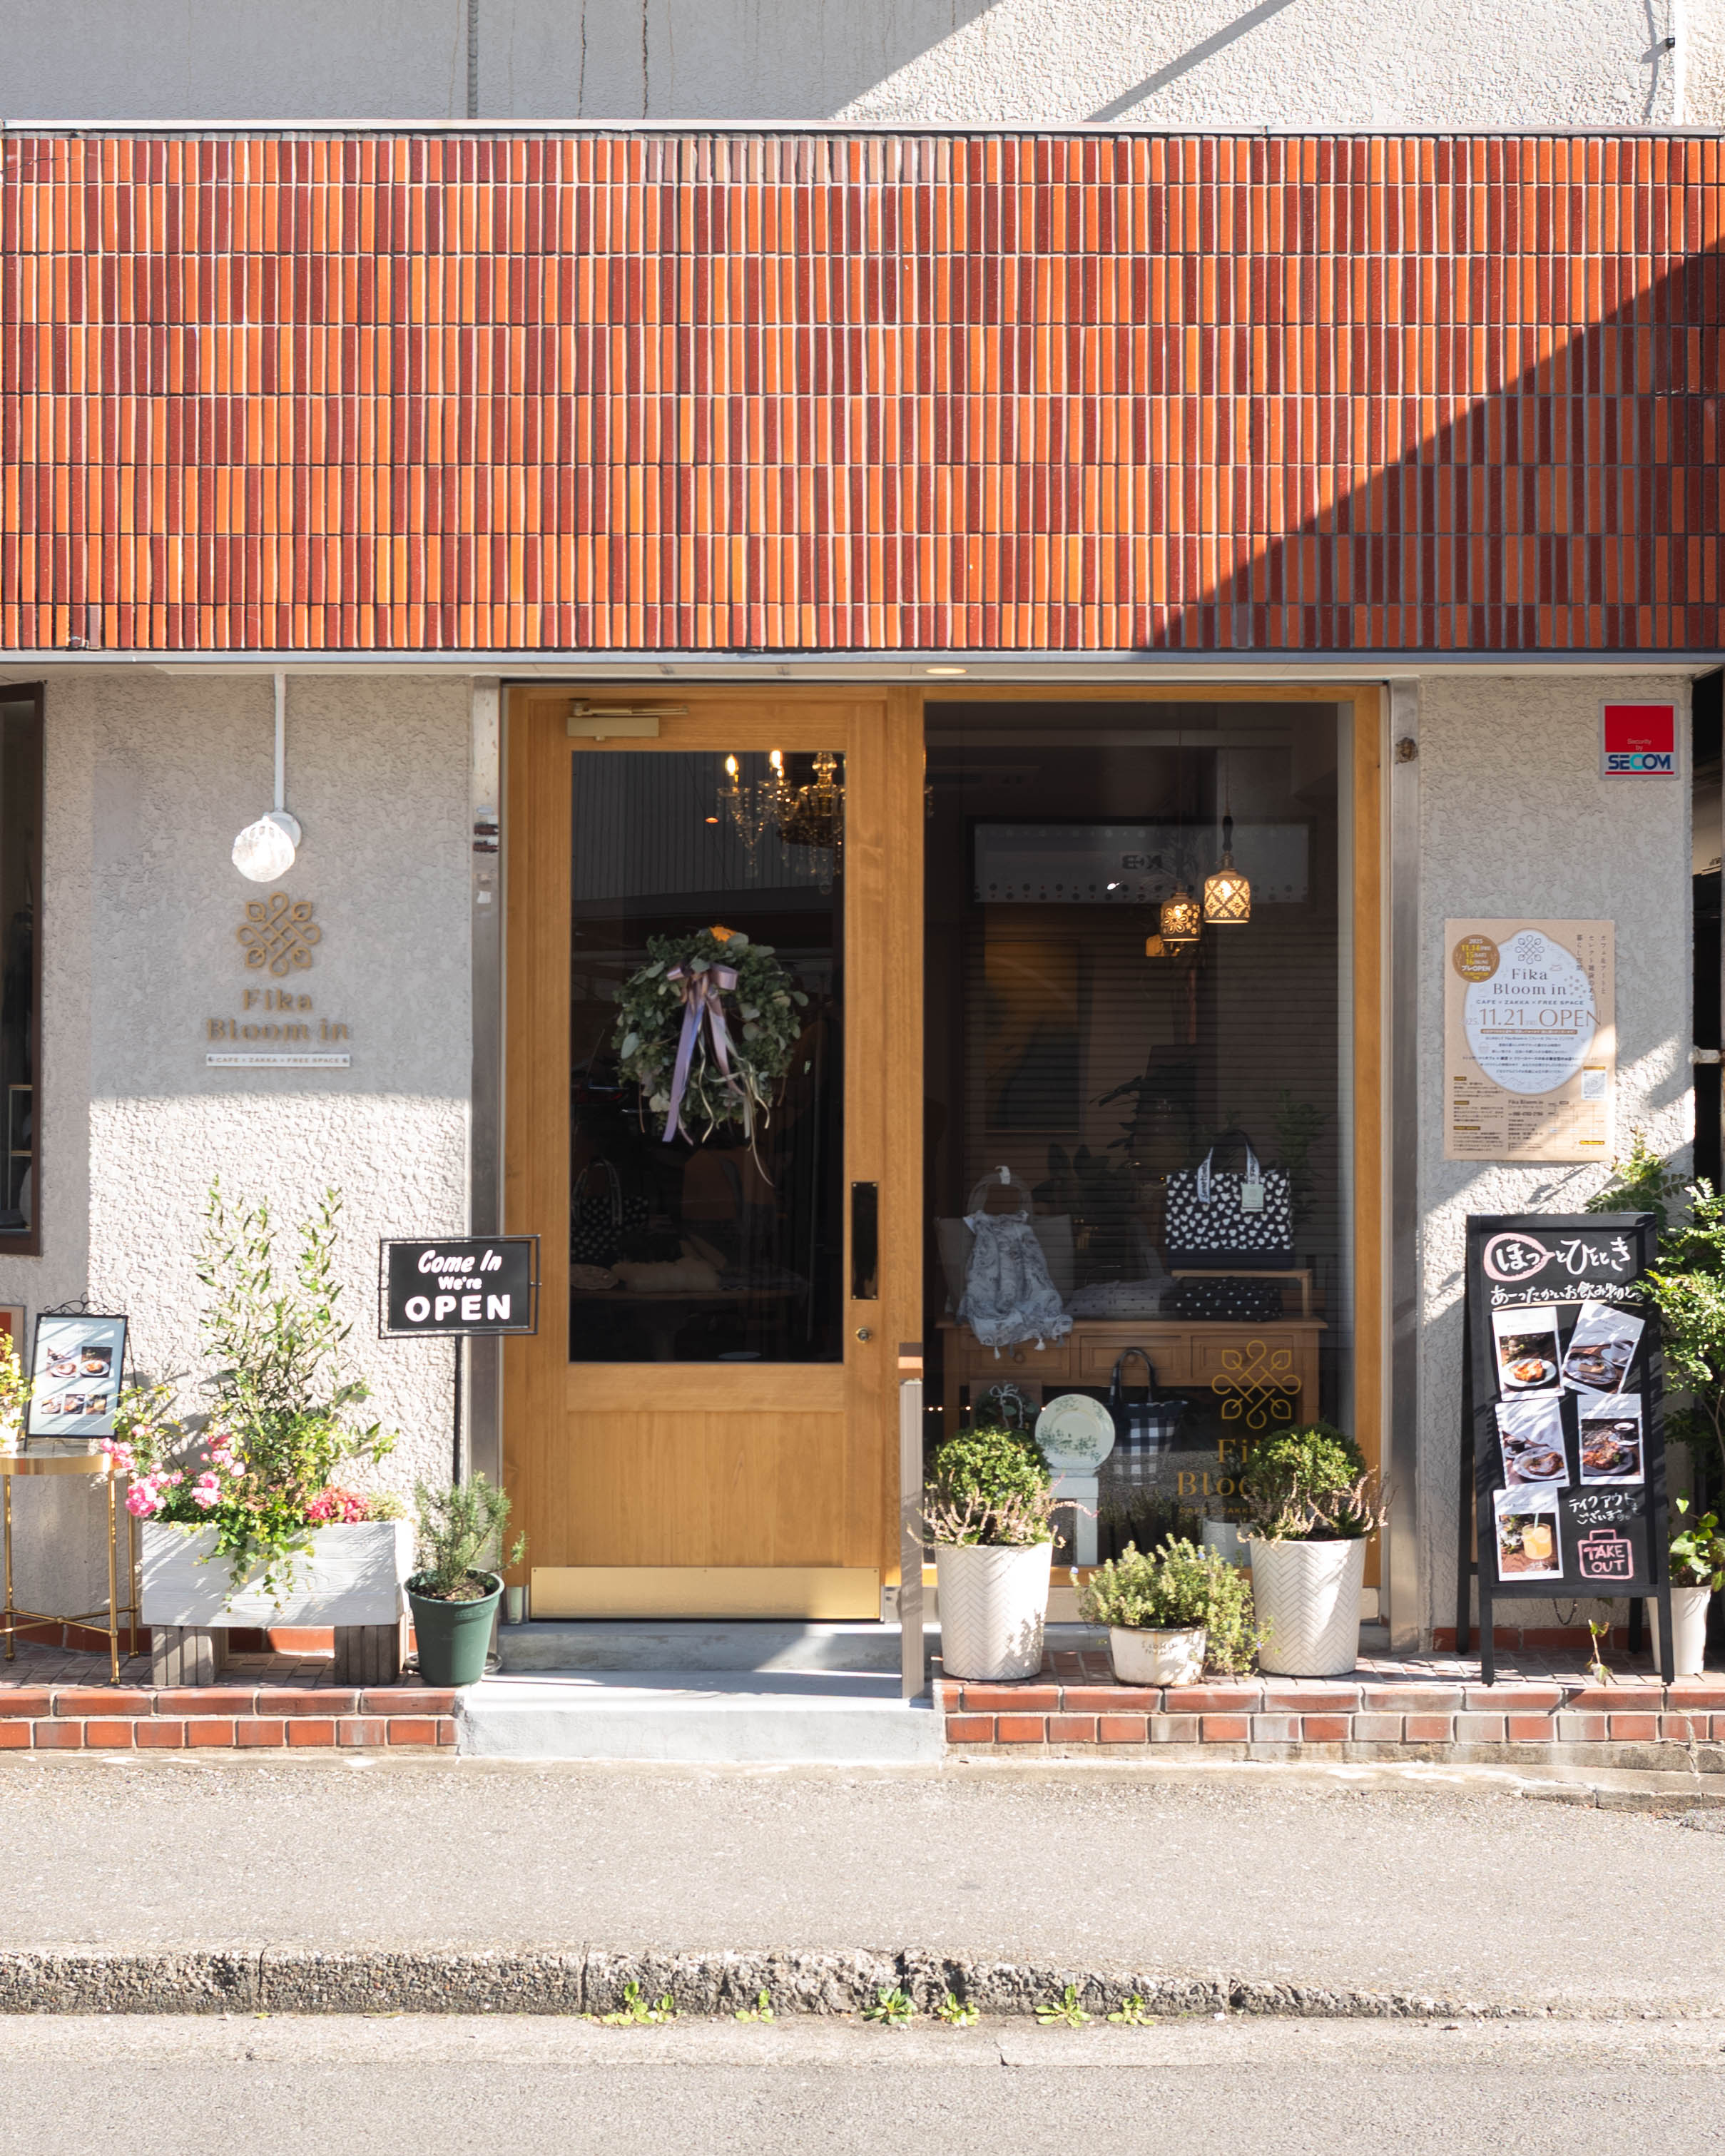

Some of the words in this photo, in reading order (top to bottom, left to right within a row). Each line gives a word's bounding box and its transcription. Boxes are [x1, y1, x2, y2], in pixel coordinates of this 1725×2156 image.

[1608, 753, 1671, 771] SECOM
[1512, 968, 1549, 980] Fika
[1493, 983, 1546, 995] Bloom
[1552, 983, 1567, 995] in
[242, 988, 313, 1011] Fika
[1479, 1008, 1524, 1025] 11.21
[1539, 1009, 1602, 1027] OPEN
[207, 1018, 309, 1039] Bloom
[320, 1018, 349, 1039] in
[418, 1249, 476, 1273] Come
[480, 1249, 502, 1271] In
[438, 1276, 482, 1291] We're
[404, 1294, 511, 1322] OPEN
[1583, 1545, 1626, 1561] TAKE
[1591, 1559, 1626, 1573] OUT
